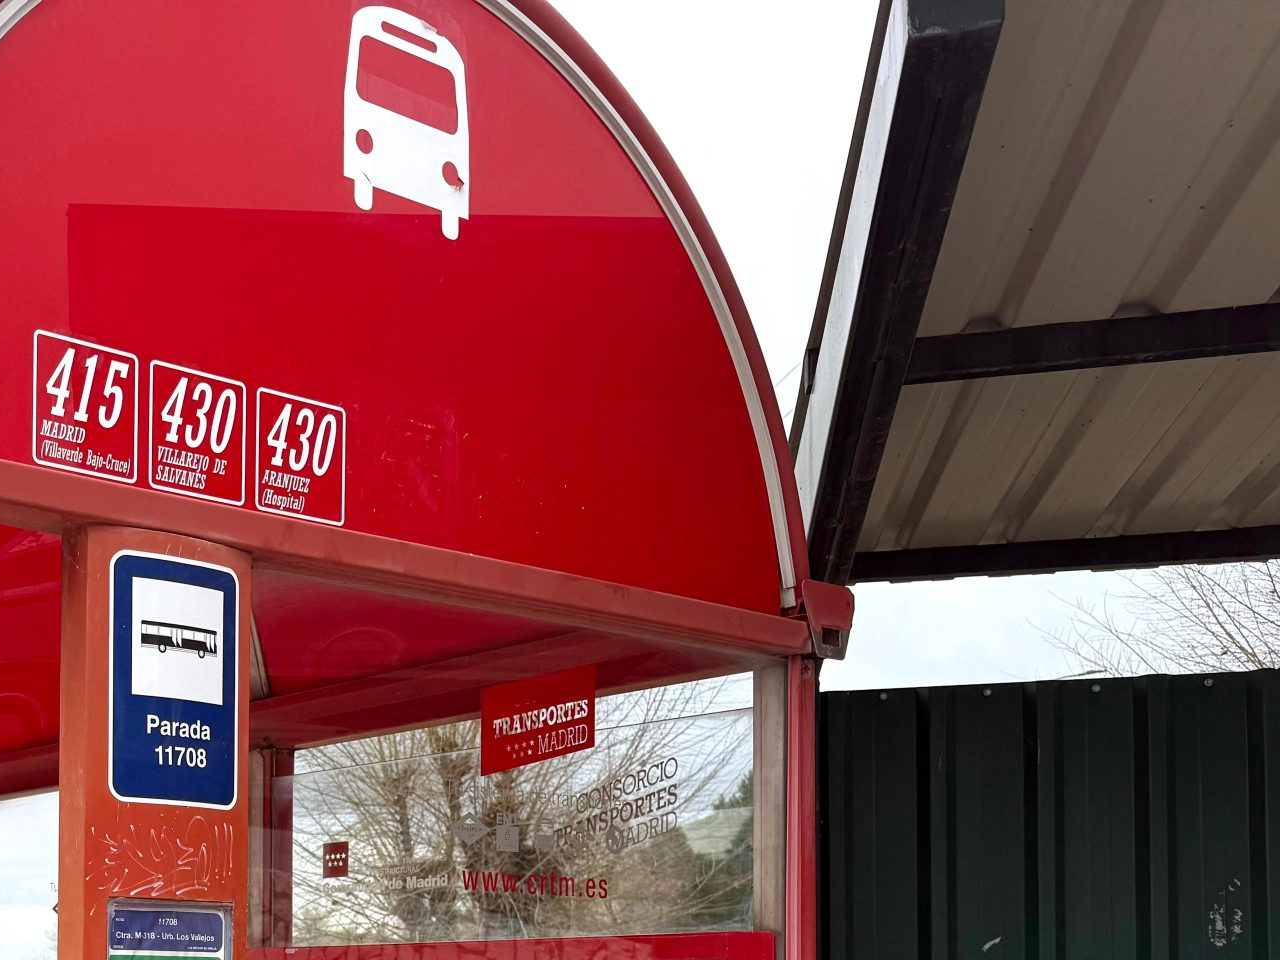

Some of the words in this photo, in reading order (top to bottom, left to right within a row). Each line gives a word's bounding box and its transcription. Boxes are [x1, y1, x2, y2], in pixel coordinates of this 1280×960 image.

[46, 348, 129, 429] 415
[160, 376, 236, 454] 430
[40, 419, 86, 444] MADRID
[266, 403, 337, 477] 430
[40, 439, 84, 464] (Villaverde
[86, 449, 131, 477] Bajo-Cruce)
[157, 445, 210, 474] VILLAREJO
[212, 458, 228, 475] DE
[261, 469, 311, 494] ARANJUEZ
[261, 488, 306, 513] (Hospital)
[146, 714, 211, 741] Parada
[492, 699, 589, 740] TRANSPORTES
[537, 723, 589, 755] MADRID
[154, 745, 208, 768] 11708
[576, 757, 678, 814] CONSORCIO
[388, 877, 403, 890] de
[406, 874, 449, 889] Madrid
[462, 870, 609, 899] www.crtm.es
[115, 931, 133, 939] Ctra.
[161, 932, 175, 940] Urb.
[176, 933, 189, 941] Los
[158, 918, 178, 926] 11708
